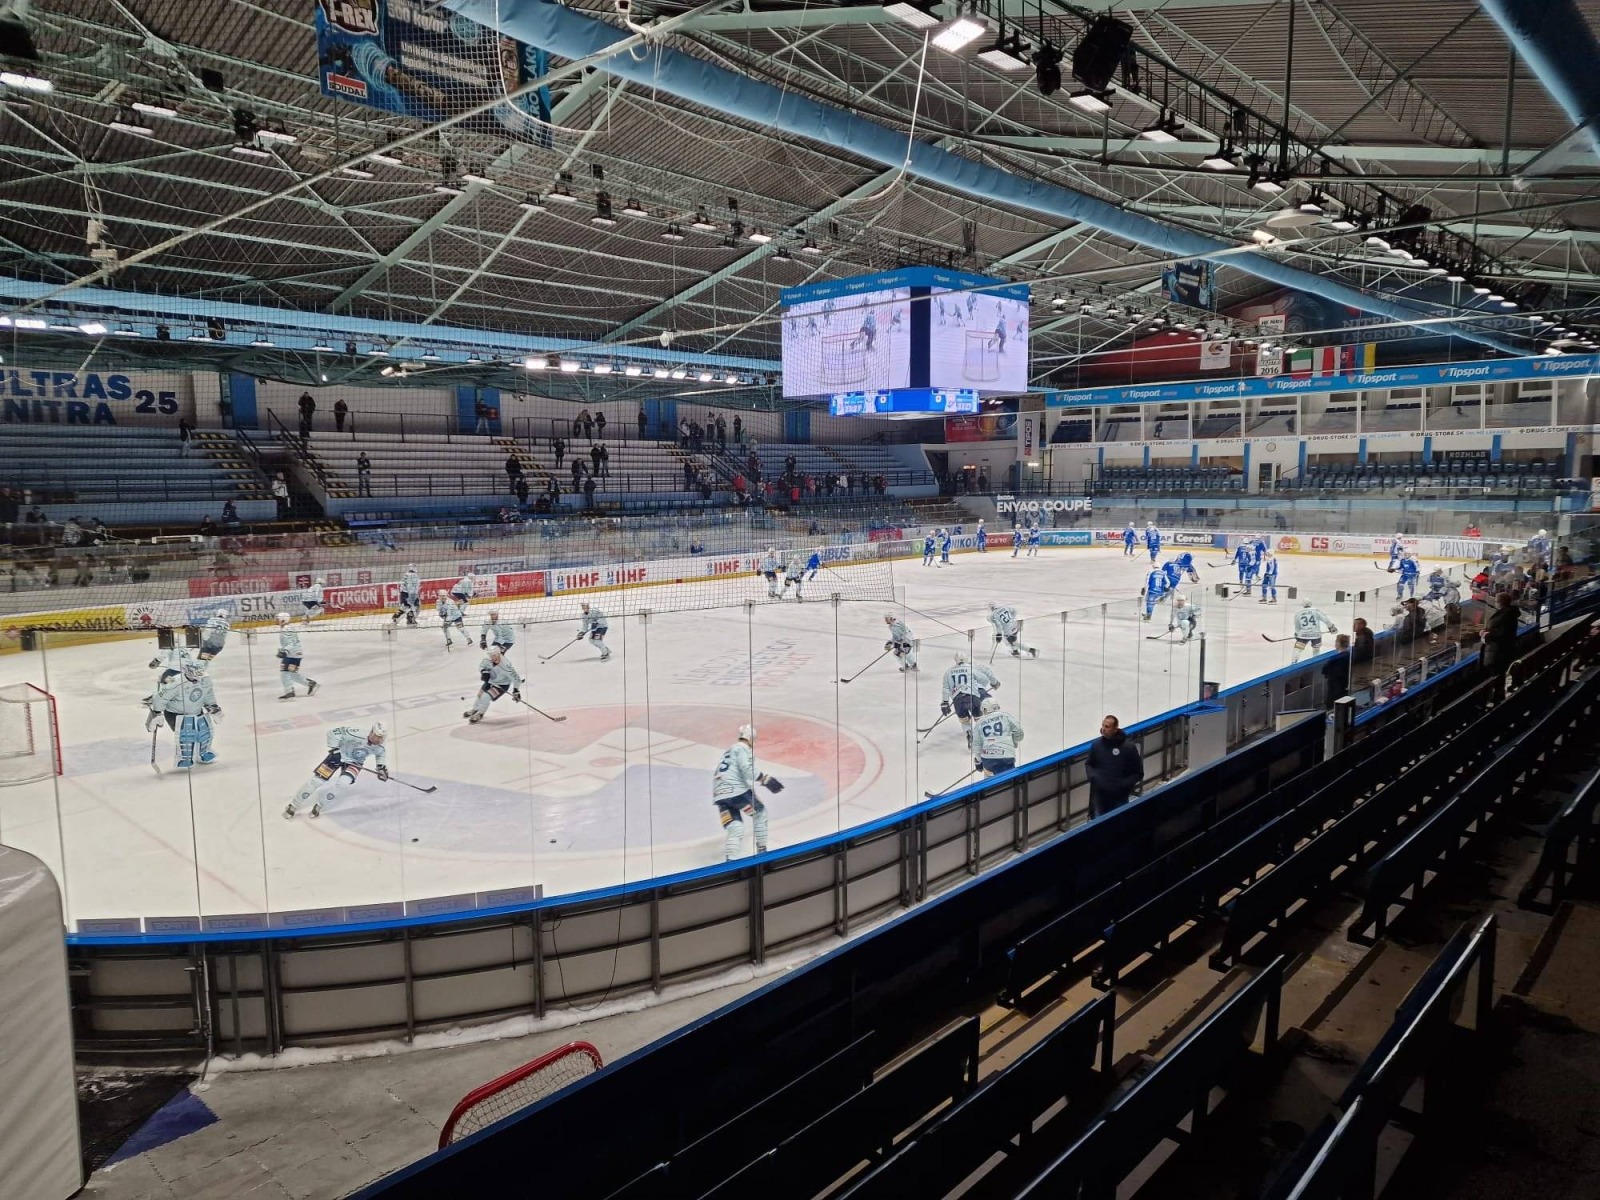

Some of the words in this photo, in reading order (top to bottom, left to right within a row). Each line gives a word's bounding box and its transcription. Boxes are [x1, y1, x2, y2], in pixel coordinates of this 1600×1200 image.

[329, 81, 366, 97] SOUDAL
[1343, 327, 1418, 342] LEGENDY
[1260, 367, 1279, 375] 2016
[1543, 358, 1590, 371] Tipsport
[1449, 365, 1490, 378] Tipsport
[0, 369, 132, 400] LTRAS
[1276, 379, 1312, 390] Tipsport
[1357, 372, 1397, 385] Tipsport
[1129, 389, 1160, 399] Tipsport
[1203, 384, 1235, 395] Tipsport
[135, 390, 179, 415] 25
[1063, 393, 1092, 402] Tipsport
[4, 399, 117, 425] NITRA
[996, 500, 1039, 513] ENYAQ
[1043, 496, 1092, 511] COUPÉ
[1052, 534, 1089, 545] Tipsport
[1176, 533, 1212, 543] Ceresit
[1311, 537, 1329, 549] CS
[714, 560, 740, 574] IIHF
[566, 572, 600, 588] IIHF
[616, 568, 647, 584] IIHF
[241, 595, 276, 613] STK
[1301, 614, 1317, 627] 34
